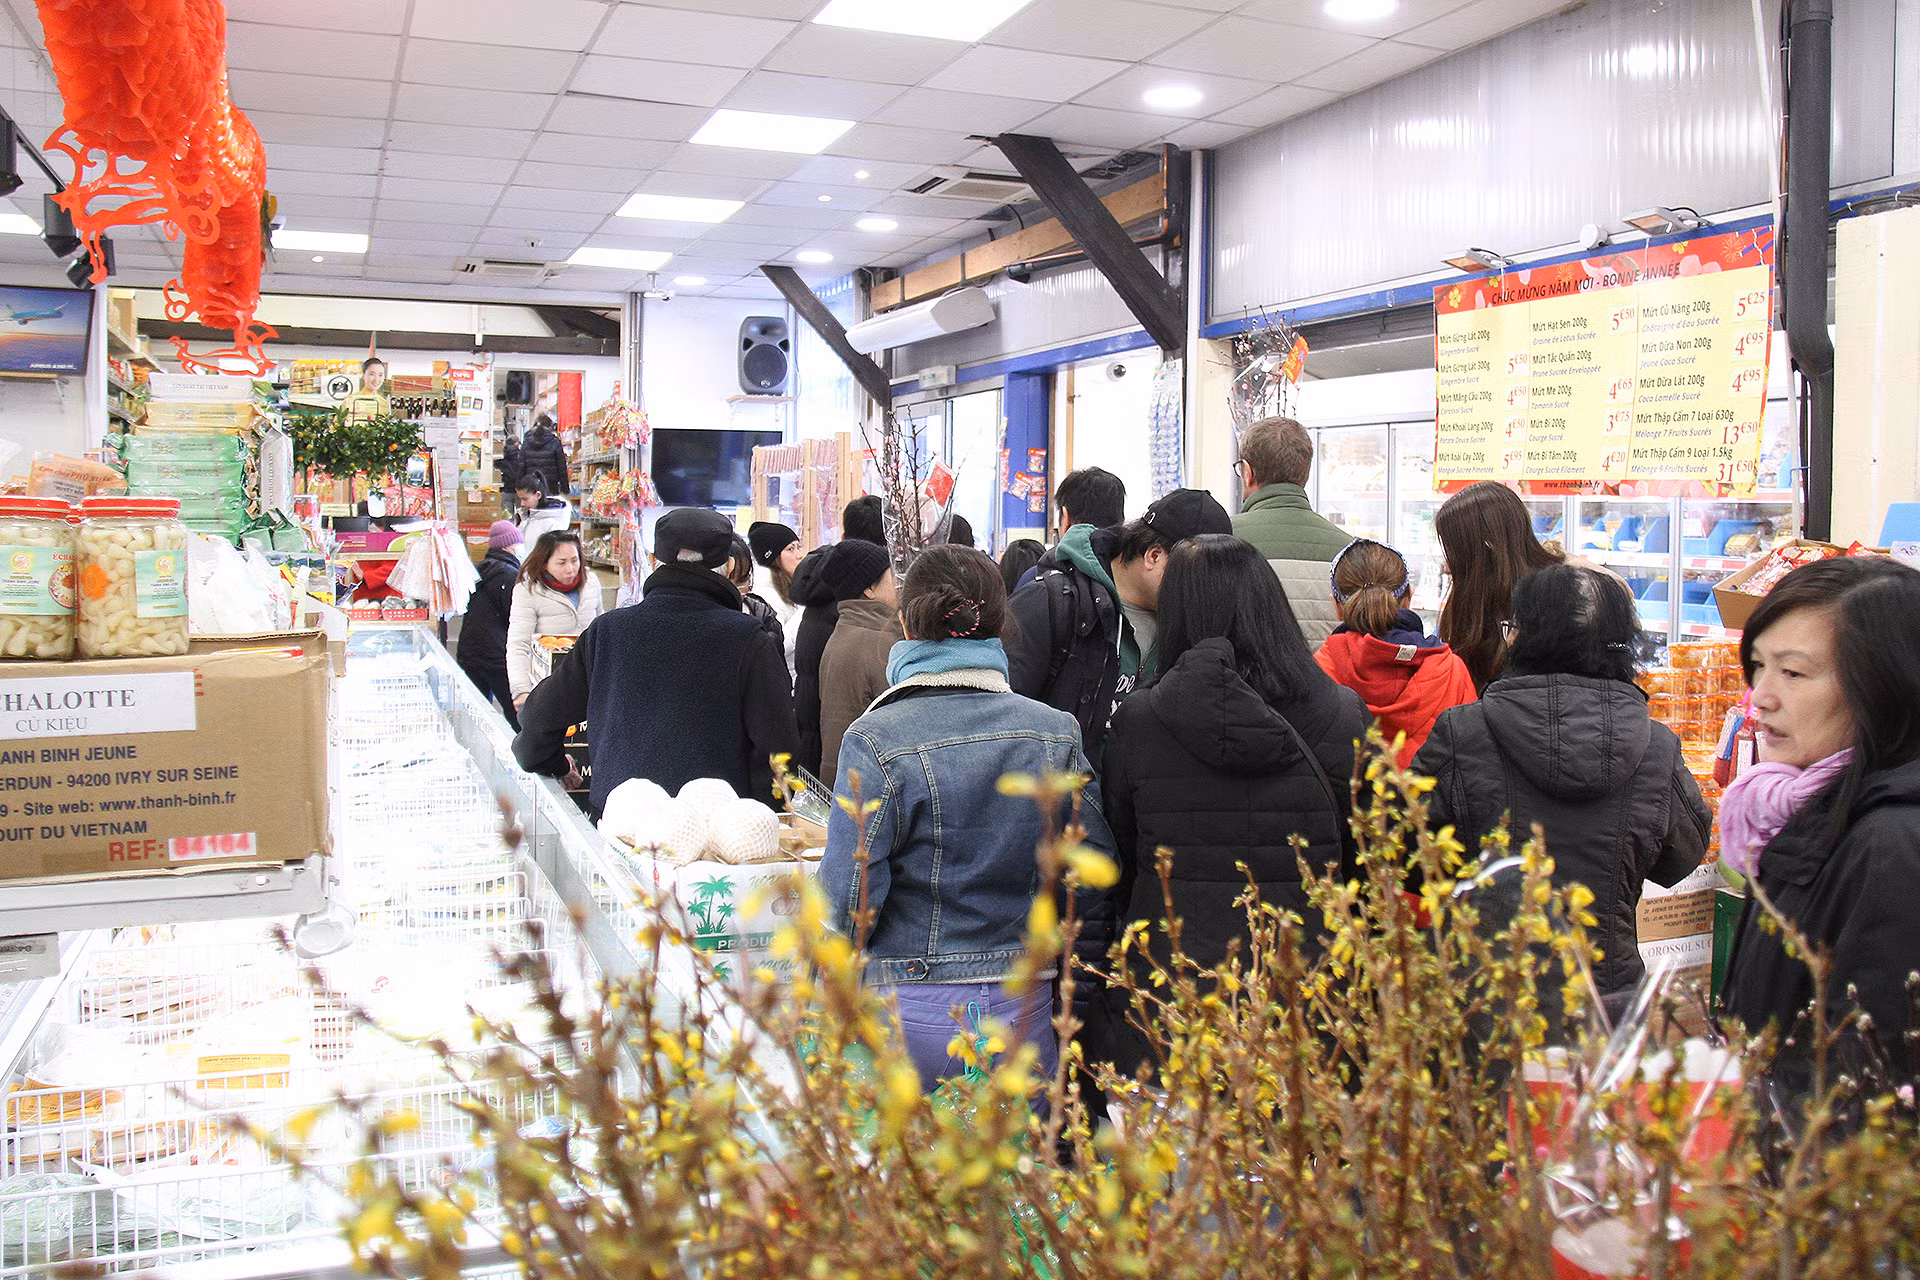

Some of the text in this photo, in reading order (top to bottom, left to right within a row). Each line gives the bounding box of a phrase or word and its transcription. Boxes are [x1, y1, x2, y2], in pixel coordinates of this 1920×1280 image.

[1492, 287, 1515, 304] CHÚC
[1518, 282, 1546, 301] MỪNG
[1549, 279, 1571, 296] NĂM
[1574, 274, 1594, 292] MỚI
[1603, 270, 1640, 287] BONNE
[1642, 261, 1681, 281] ANNÉE
[1692, 300, 1711, 313] 200g
[1737, 291, 1766, 317] 5€25
[1559, 319, 1571, 329] Sen
[1572, 317, 1588, 329] 200g
[1612, 308, 1635, 331] 5€50
[1477, 330, 1490, 341] 200g
[1676, 340, 1692, 350] Non
[1693, 337, 1712, 350] 200g
[1735, 332, 1764, 355] 4€95
[1576, 350, 1592, 362] 200g
[1660, 357, 1676, 366] Coco
[1609, 378, 1633, 399] 4€65
[1687, 374, 1705, 387] 200g
[1732, 369, 1761, 392] 4€95
[1479, 391, 1492, 402] 200g
[1546, 386, 1556, 396] Me
[1557, 385, 1572, 397] 200g
[1638, 395, 1653, 403] Coco
[1551, 418, 1566, 430] 200g
[1606, 411, 1630, 432] 3€75
[1636, 412, 1652, 424] Mứt
[1691, 411, 1696, 421] 7
[1715, 409, 1734, 423] 630g
[1481, 421, 1494, 432] 200g
[1669, 427, 1688, 437] Fruits
[1722, 421, 1758, 445] 13€50
[1473, 452, 1485, 463] 200g
[1562, 450, 1577, 462] 200g
[1602, 451, 1626, 472] 4€20
[1633, 447, 1648, 459] Mứt
[1687, 447, 1692, 458] 9
[1712, 446, 1733, 460] 1.5kg
[1716, 460, 1753, 483] 31€50
[0, 689, 136, 713] HALOTTE
[15, 715, 87, 734] CỦ KIỆU
[41, 748, 80, 763] BINH
[85, 745, 137, 761] JEUNE
[67, 773, 111, 788] 94200
[115, 771, 152, 785] IVRY
[156, 769, 188, 783] SUR
[193, 766, 239, 781] SEINE
[24, 802, 54, 816] Site
[59, 801, 94, 814] web:
[99, 791, 236, 812] www.thanh-binh.fr
[40, 826, 65, 840] DU
[70, 820, 147, 837] VIETNAM
[108, 839, 165, 862] REF:
[1641, 941, 1694, 959] COROSSOL
